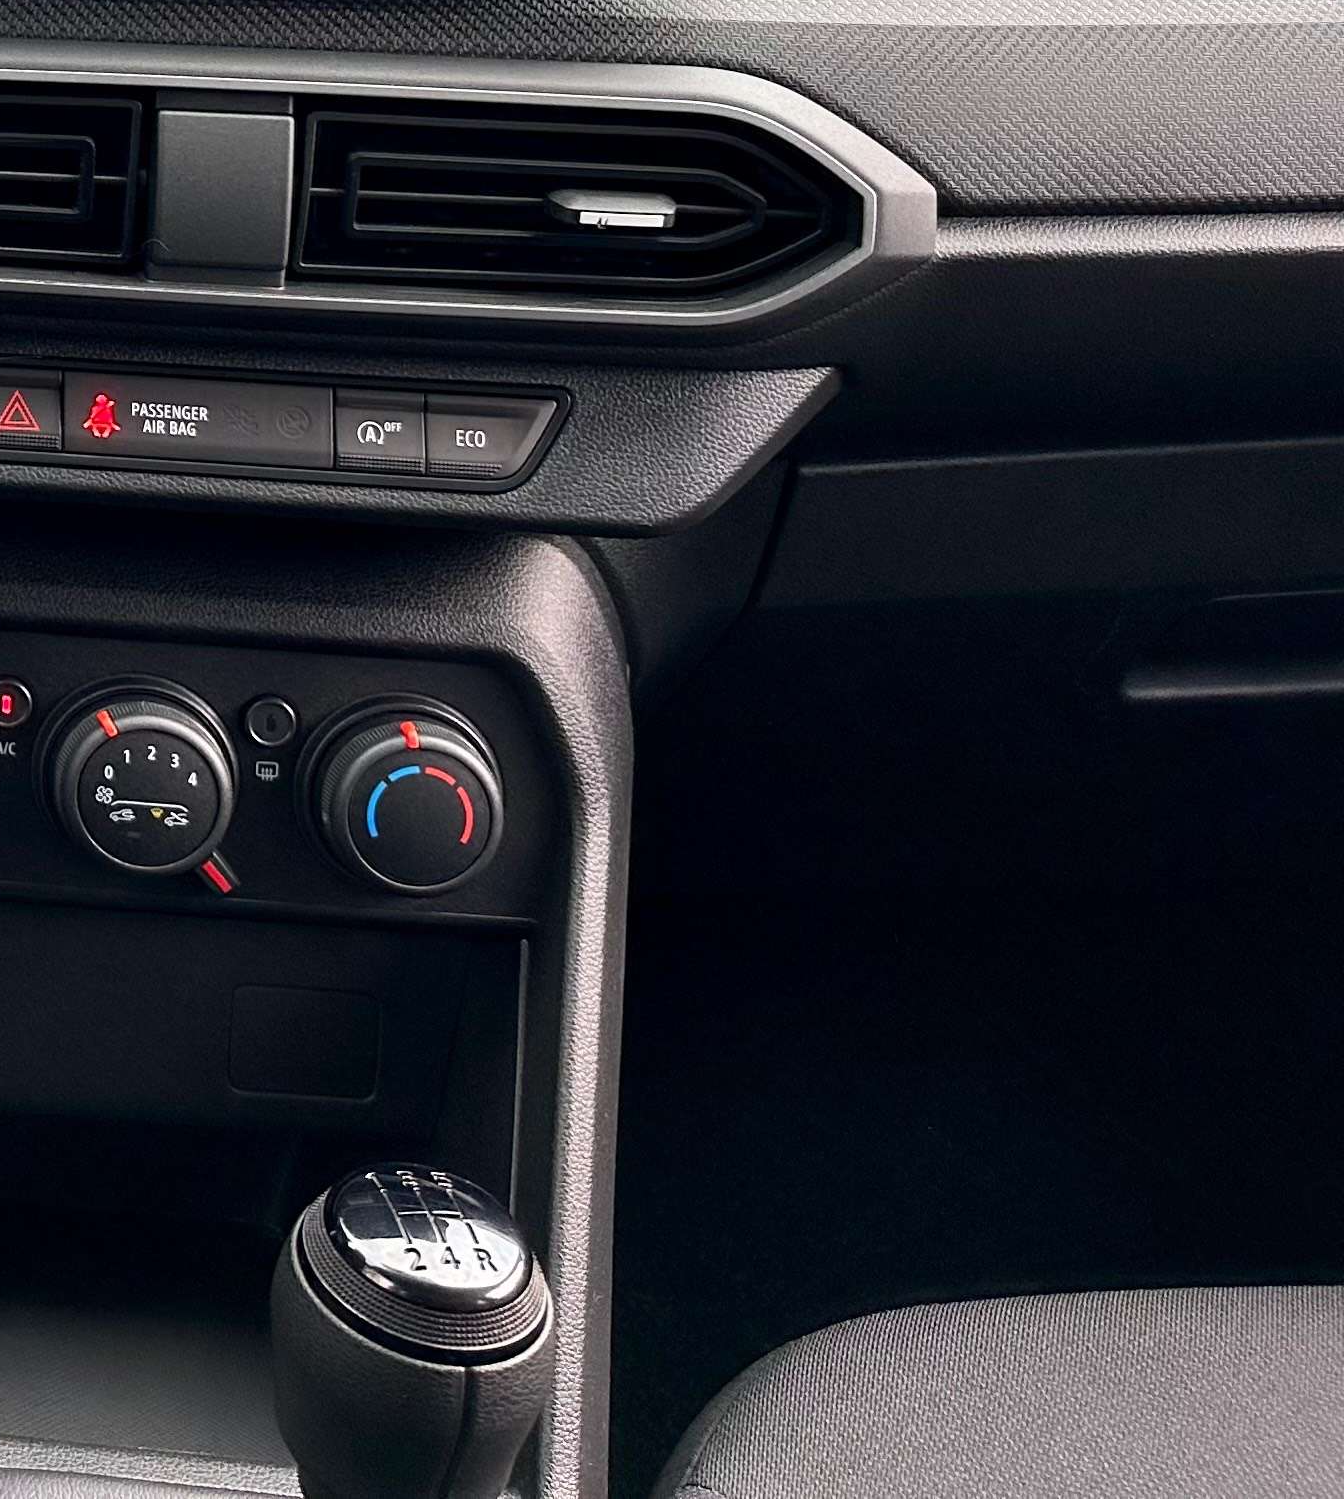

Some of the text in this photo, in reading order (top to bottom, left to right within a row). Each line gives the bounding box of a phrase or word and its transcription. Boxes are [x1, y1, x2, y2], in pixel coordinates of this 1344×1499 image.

[131, 402, 209, 422] PASSENGER
[142, 416, 198, 437] AIR BAG
[384, 421, 403, 433] OFF
[455, 429, 486, 448] ECO
[104, 745, 198, 787] 0 1 2 3 4
[404, 1246, 499, 1272] 2 4 R
